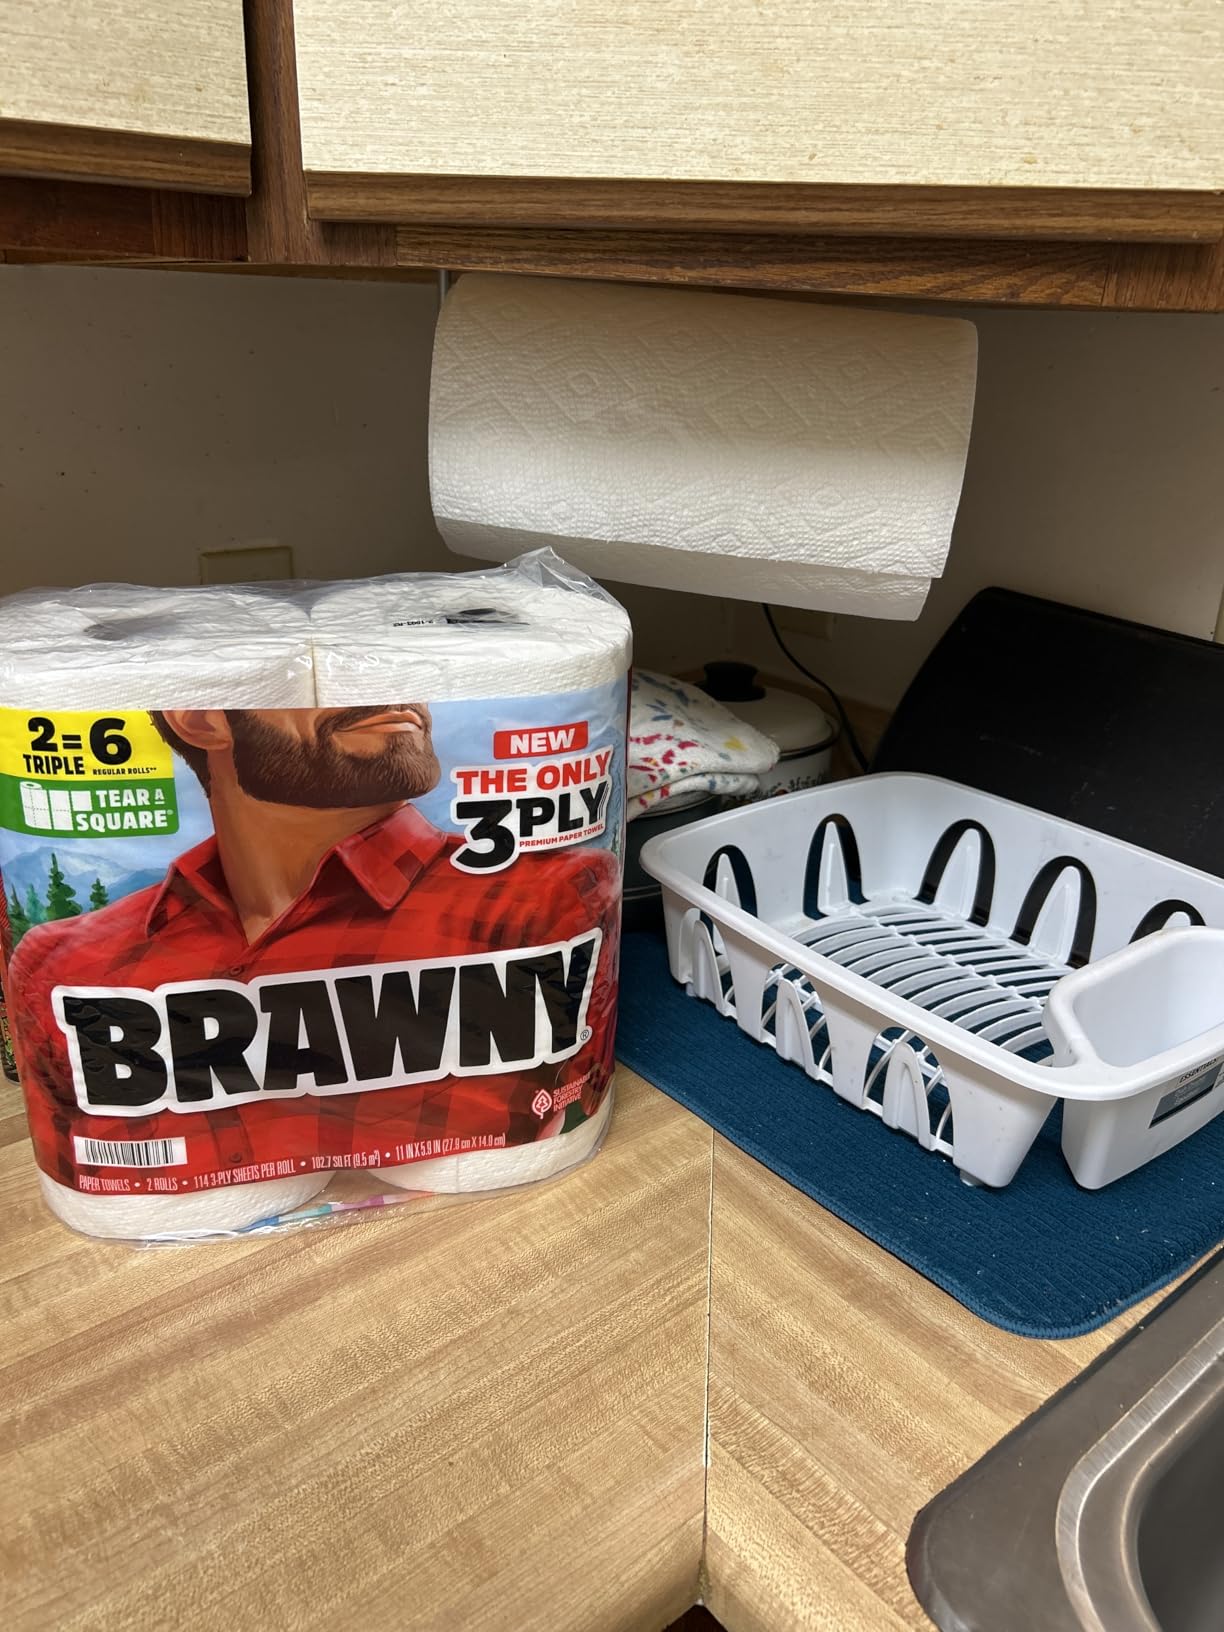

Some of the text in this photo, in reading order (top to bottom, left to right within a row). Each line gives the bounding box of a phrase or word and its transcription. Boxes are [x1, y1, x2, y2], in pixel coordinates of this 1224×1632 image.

[510, 728, 576, 755] NEW
[23, 754, 86, 776] TRIPLE
[92, 768, 126, 776] REGULAR
[456, 750, 611, 795] THE ONLY
[96, 788, 165, 809] TEAR A
[519, 823, 604, 848] PREMIUM PAPER TOWEL
[552, 1083, 584, 1105] FORESTRY
[395, 1144, 405, 1161] 11
[405, 1142, 414, 1159] IN
[414, 1142, 421, 1158] X
[432, 1139, 441, 1154] IN
[460, 1139, 471, 1150] cm
[471, 1136, 477, 1148] X
[493, 1132, 506, 1147] cm)
[311, 1156, 331, 1169] 102.7
[343, 1154, 352, 1167] FT
[352, 1151, 367, 1169] (9.5
[79, 1174, 131, 1191] PAPER TOWELS
[146, 1177, 178, 1191] 2 ROLLS
[193, 1158, 297, 1189] 114 3-PLY SHEETS PER ROLL
